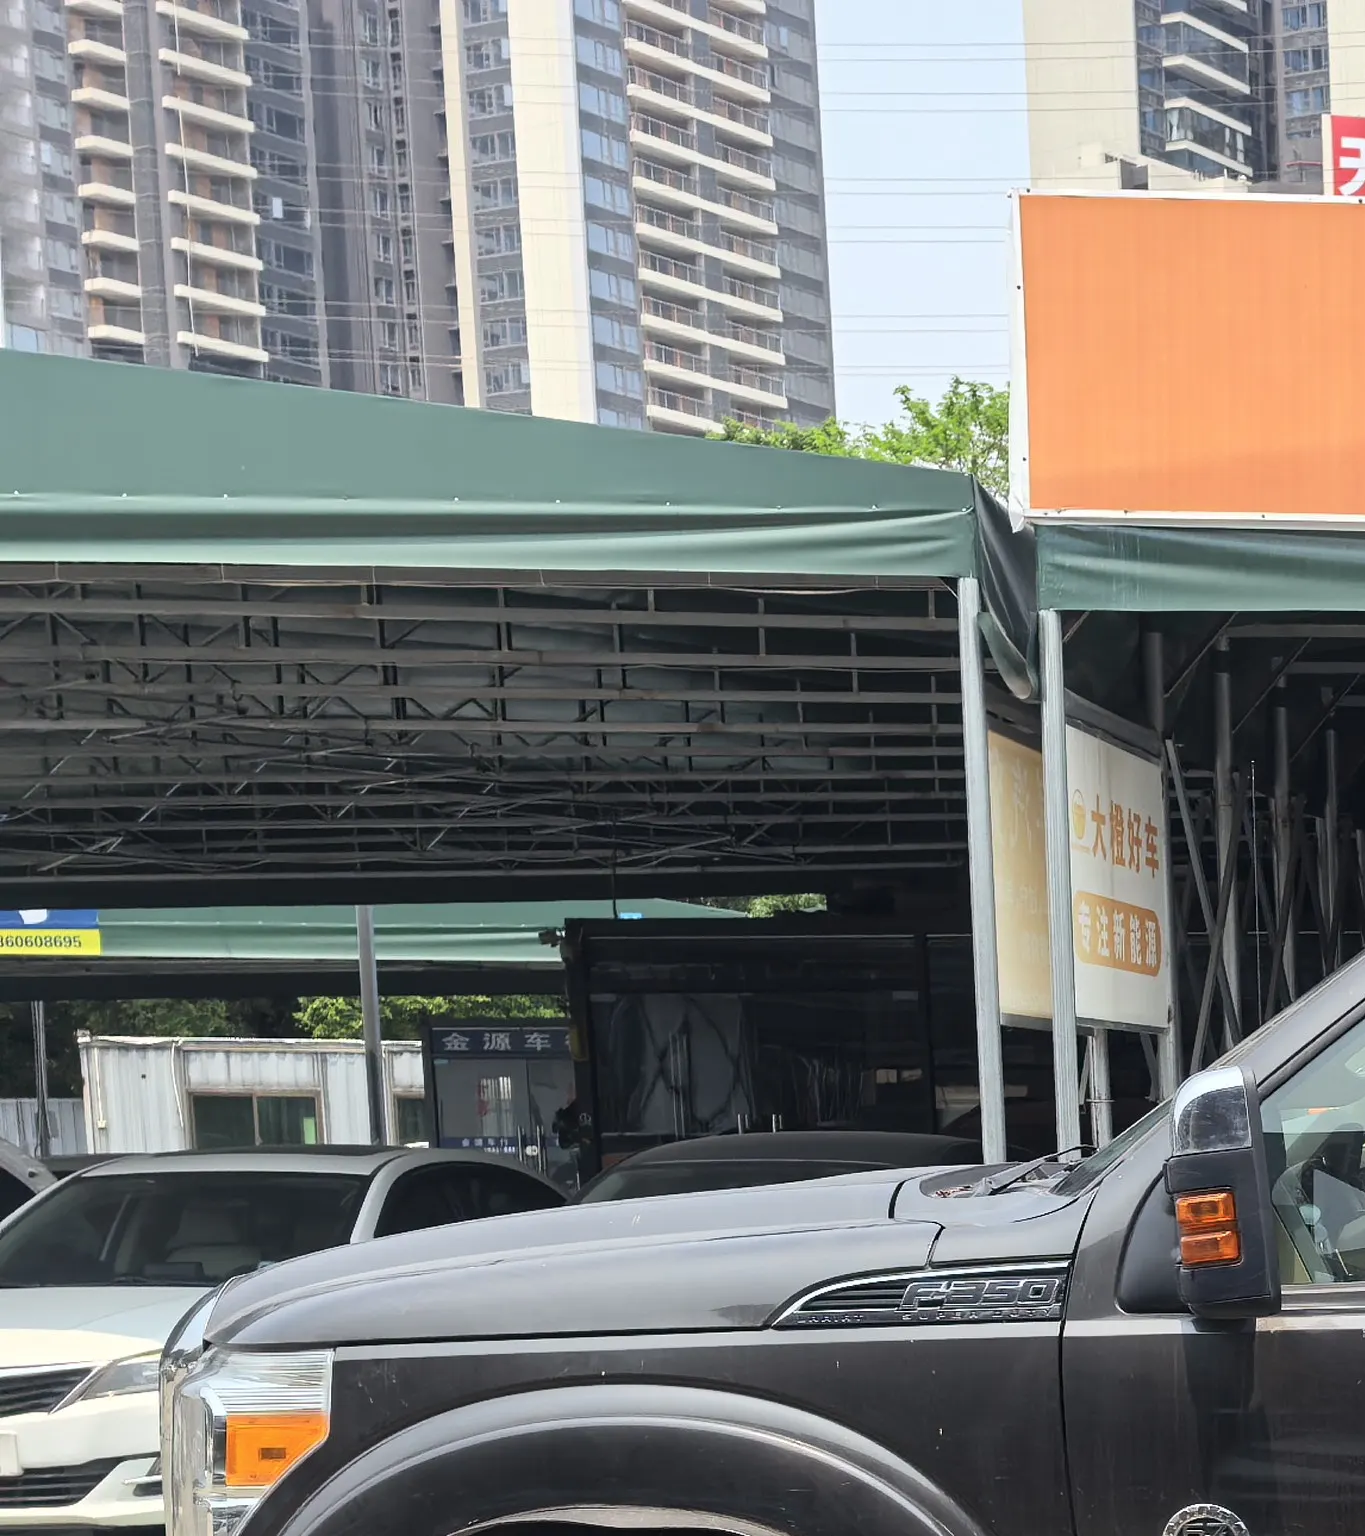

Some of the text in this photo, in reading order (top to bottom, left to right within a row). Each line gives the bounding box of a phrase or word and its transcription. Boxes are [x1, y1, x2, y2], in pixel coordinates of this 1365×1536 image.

[1090, 794, 1160, 878] 大橙好车
[1078, 900, 1158, 968] 专注新能源
[441, 1032, 571, 1051] 金源车
